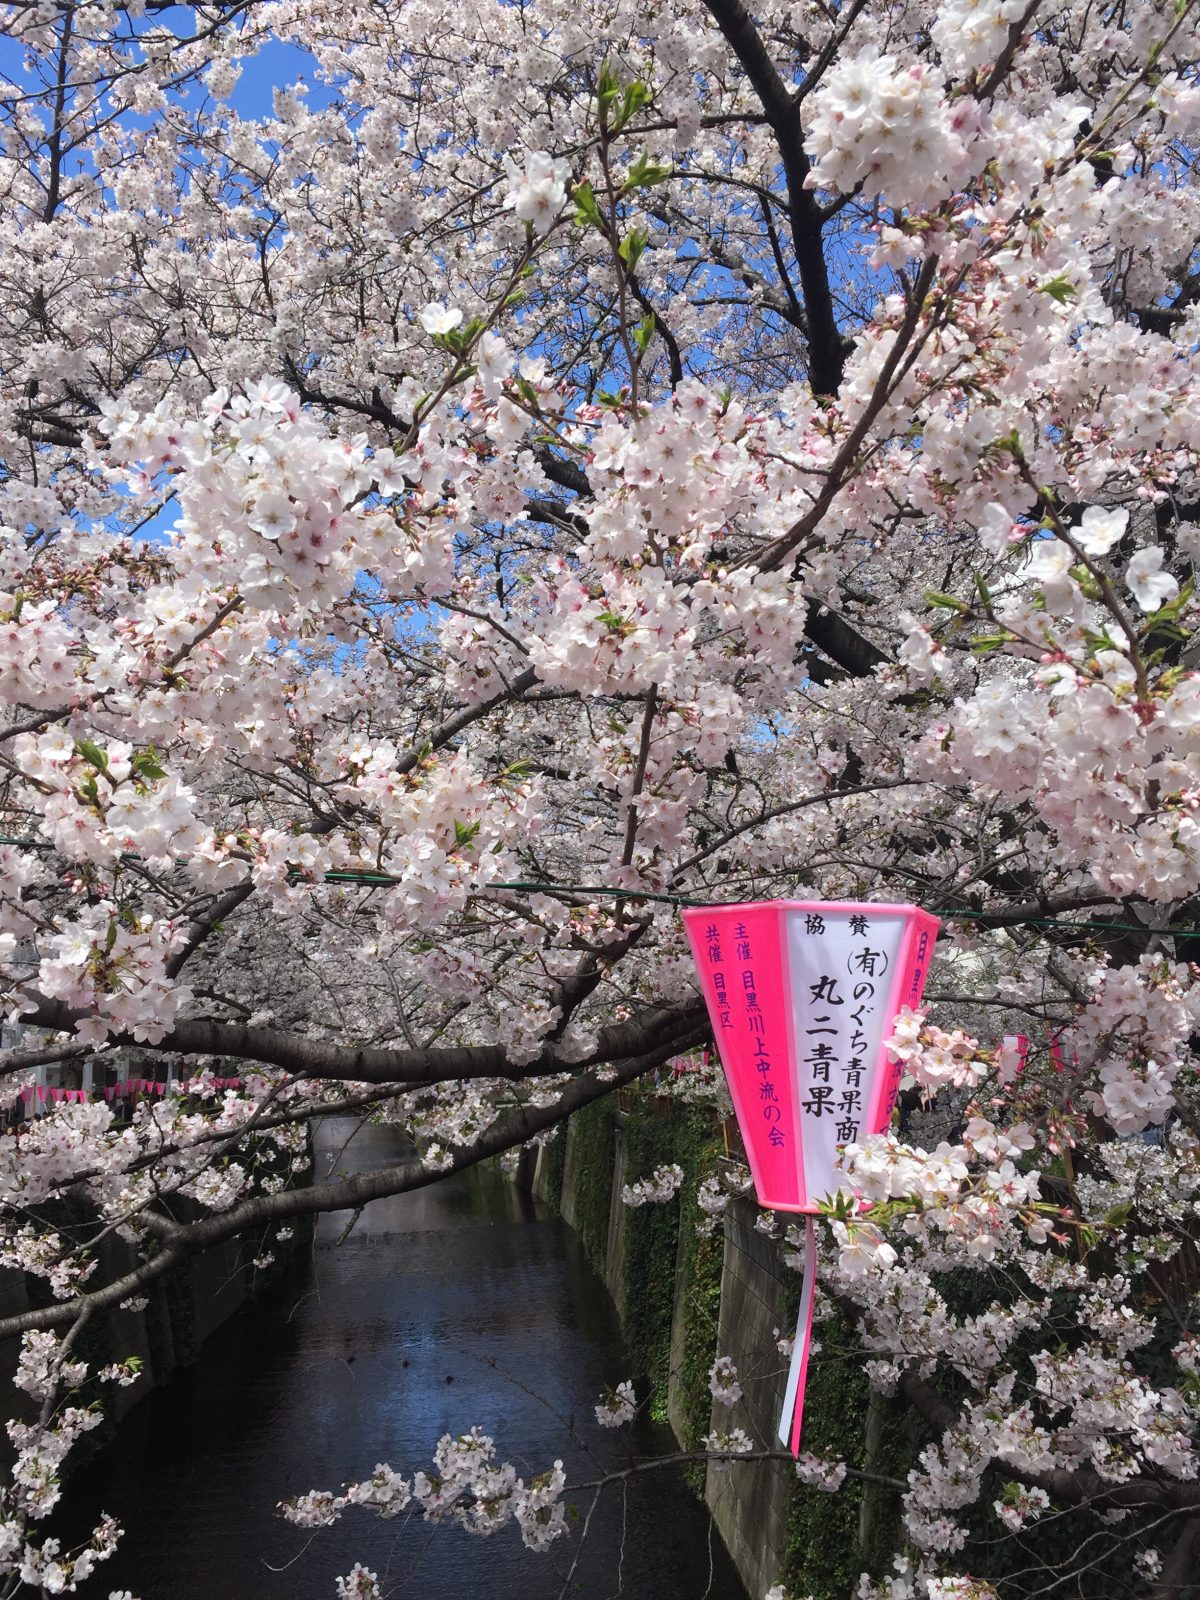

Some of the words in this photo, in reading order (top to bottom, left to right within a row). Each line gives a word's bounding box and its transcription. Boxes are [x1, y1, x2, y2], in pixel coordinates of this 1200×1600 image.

[705, 924, 724, 963] 共催
[734, 922, 753, 961] 主催
[713, 971, 734, 1028] 目黒区
[742, 970, 785, 1148] 目黒川上中流の会
[802, 975, 845, 1118] 丸二青果
